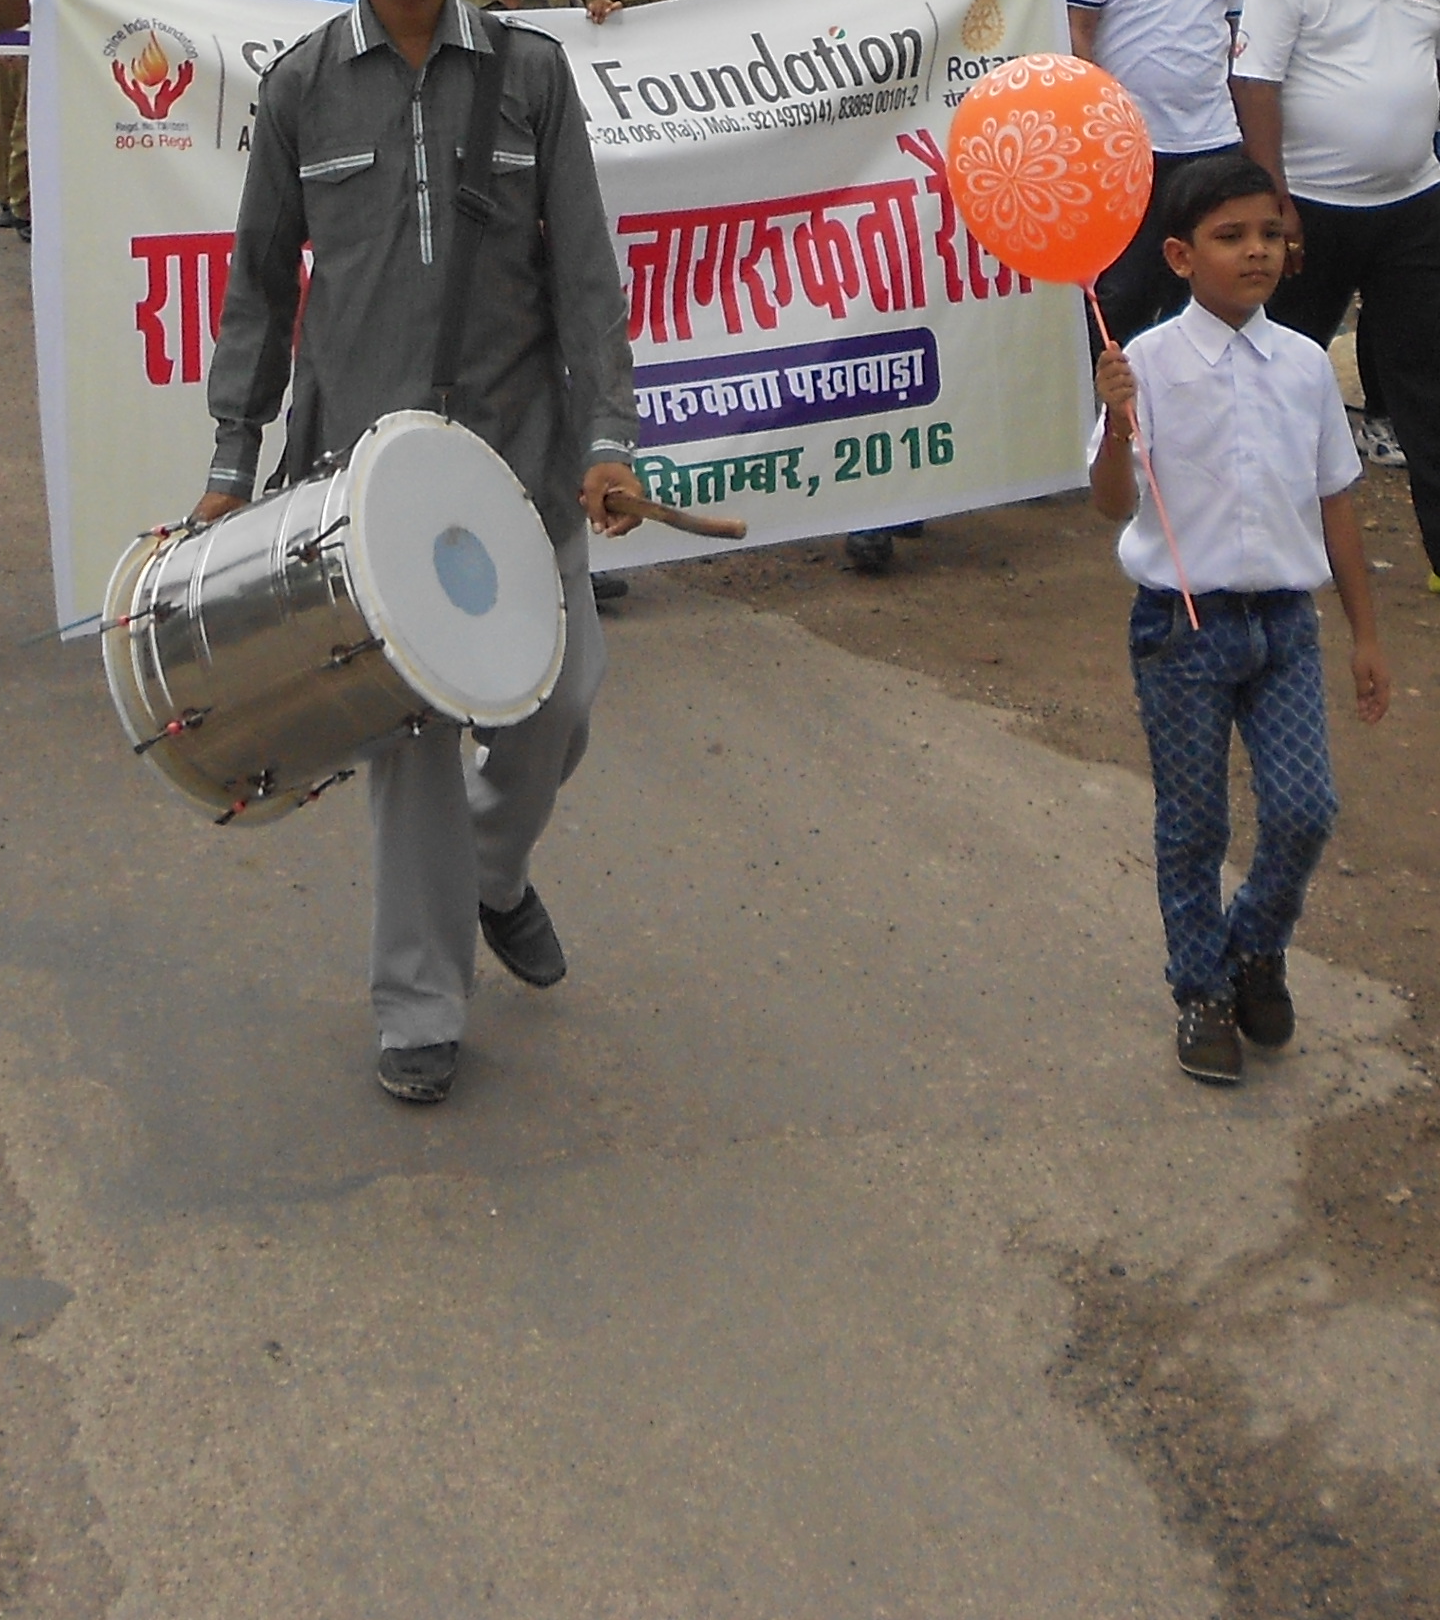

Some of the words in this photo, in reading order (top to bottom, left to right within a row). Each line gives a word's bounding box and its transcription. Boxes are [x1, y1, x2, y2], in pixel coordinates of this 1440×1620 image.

[103, 30, 127, 57] Shine
[123, 18, 150, 35] India
[152, 18, 198, 58] Foundation
[592, 25, 922, 120] Foundation
[947, 56, 1026, 82] Rota
[115, 133, 154, 150] 80-G
[158, 133, 193, 151] Regd
[628, 123, 662, 143] 006
[834, 421, 956, 484] 2016
